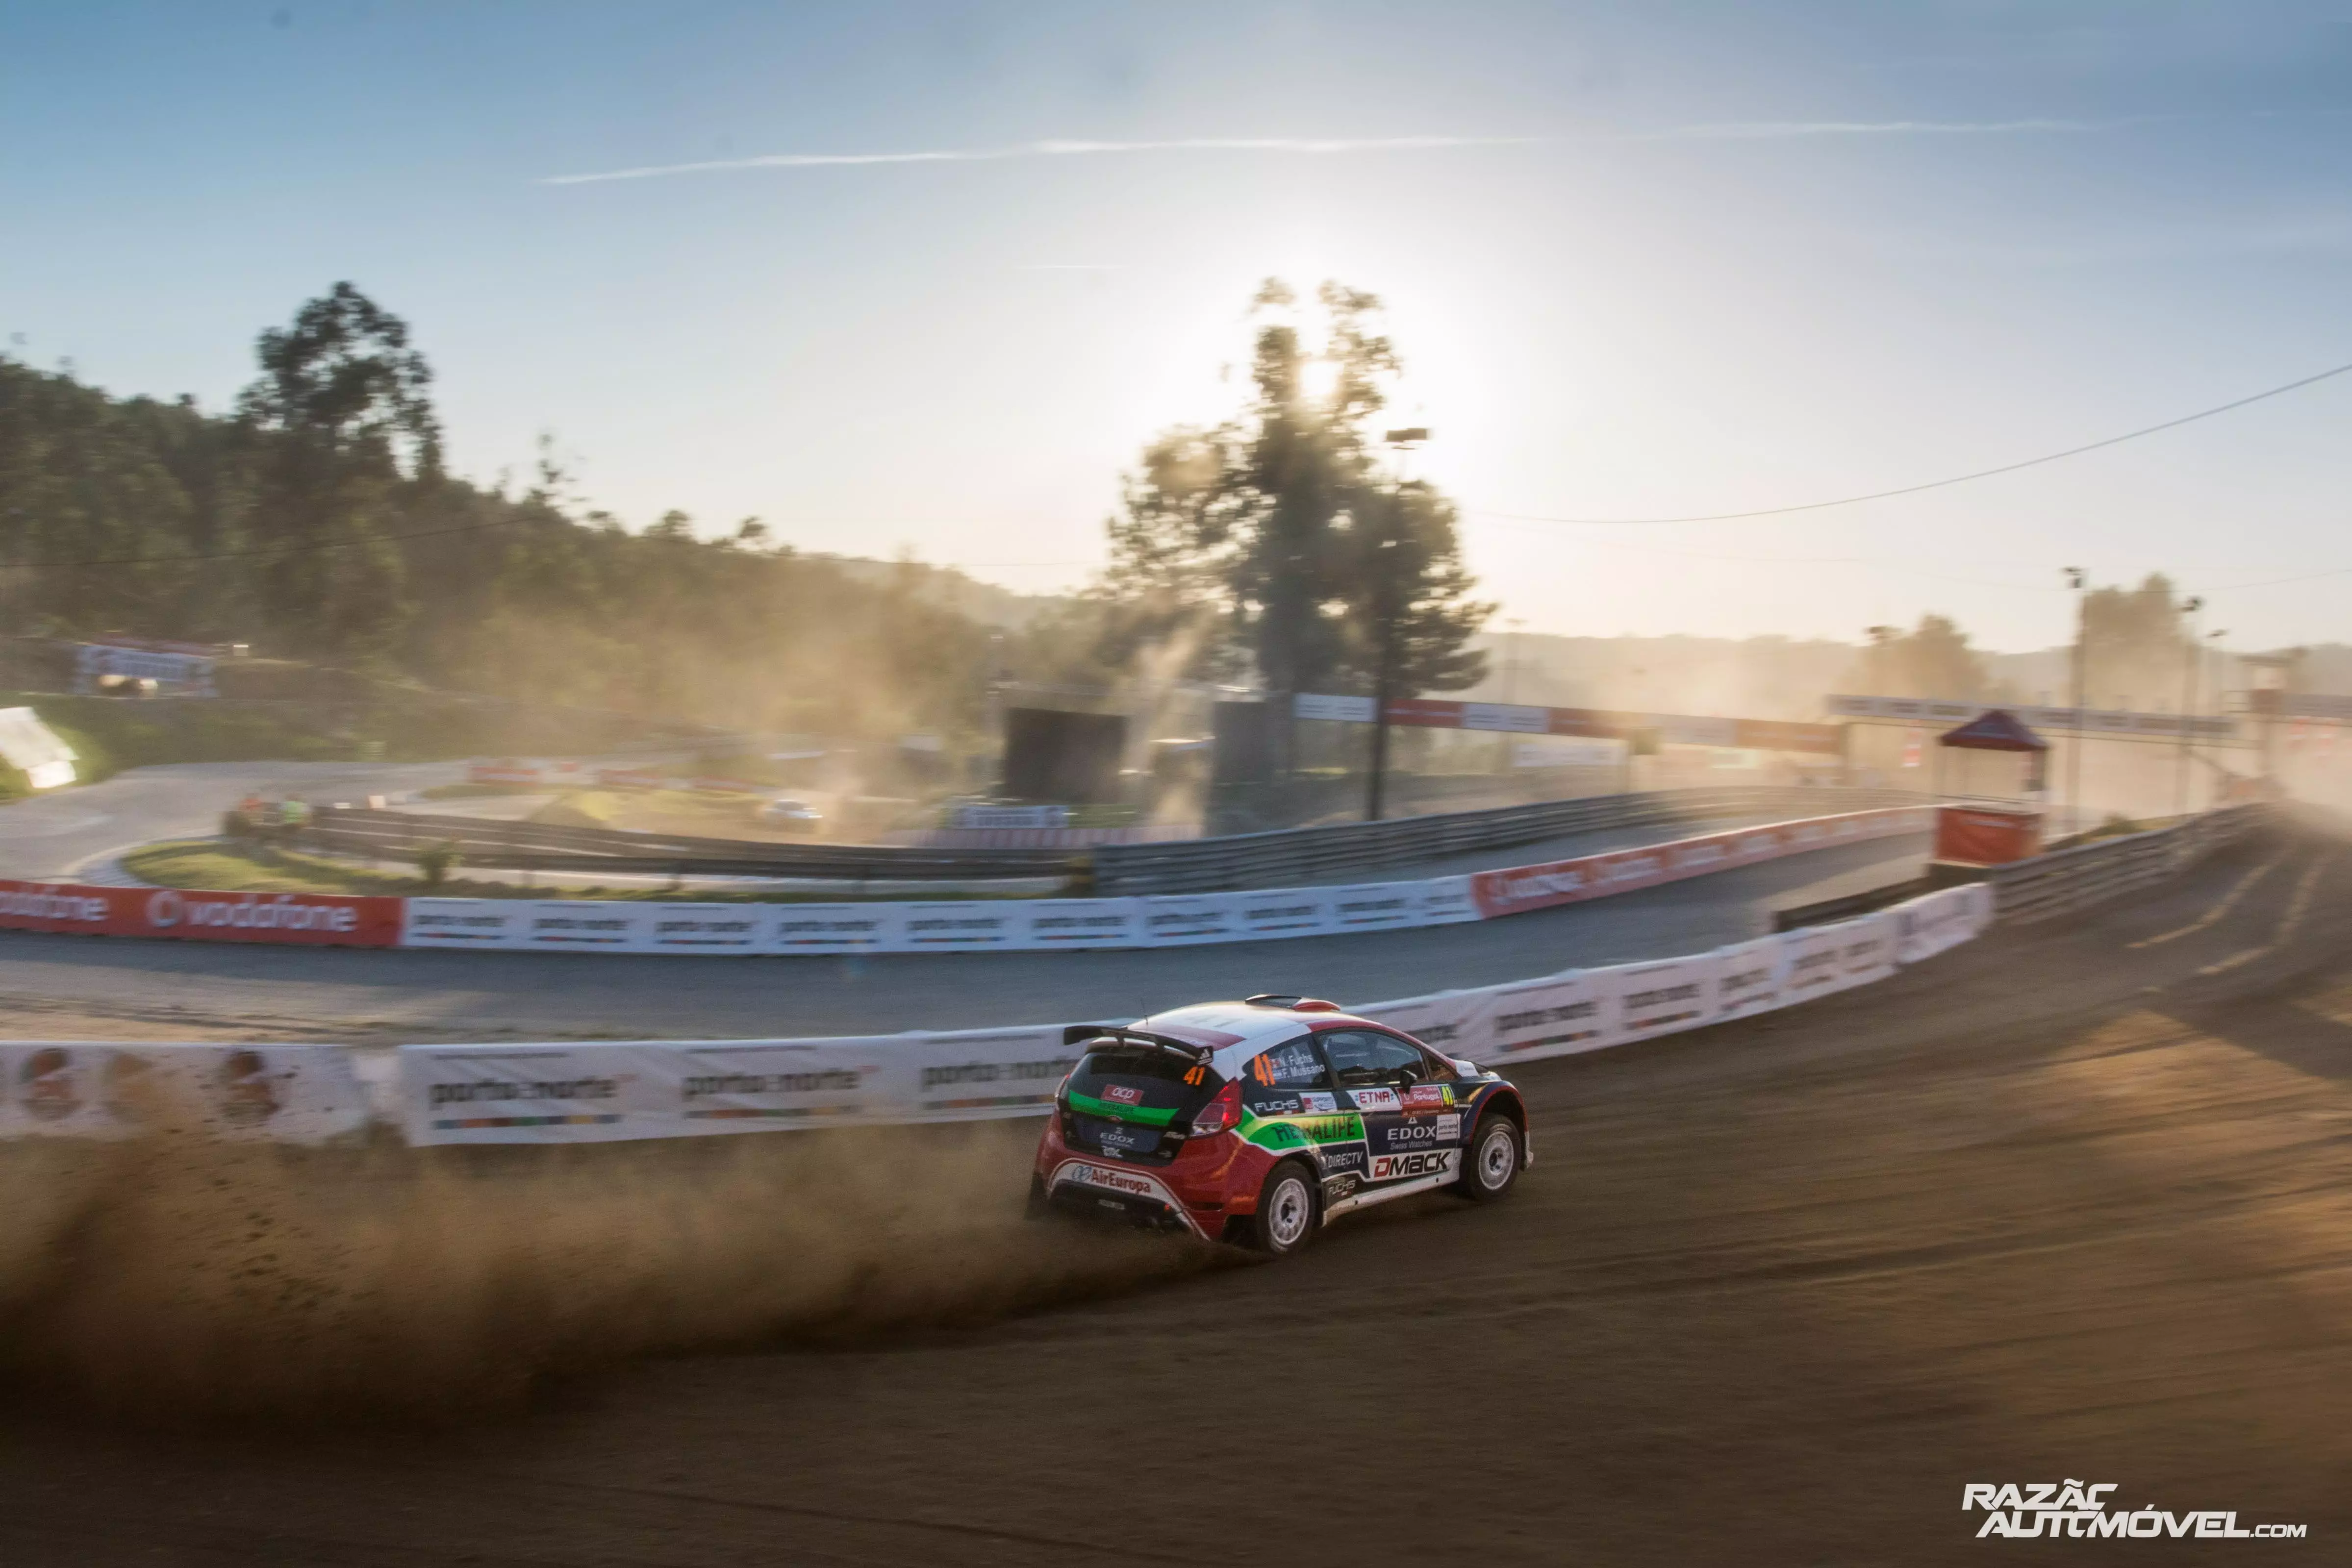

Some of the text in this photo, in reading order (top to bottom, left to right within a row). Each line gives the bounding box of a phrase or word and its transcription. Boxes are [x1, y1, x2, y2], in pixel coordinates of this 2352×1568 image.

[188, 893, 358, 932] vodafone
[1289, 1053, 1314, 1066] Fuchs
[1183, 1066, 1205, 1086] 41
[1254, 1053, 1275, 1086] 41
[1290, 1064, 1325, 1077] Mussano
[1359, 1091, 1391, 1104] ETNA
[1442, 1086, 1454, 1105] 41
[1254, 1099, 1299, 1112] FUCHS
[1099, 1132, 1136, 1144] EDOX
[1274, 1117, 1355, 1142] HEALIFE
[1388, 1125, 1436, 1141] EDOX
[1390, 1140, 1432, 1150] Swiss Watches
[1327, 1150, 1363, 1168] DIRECTV
[1091, 1169, 1151, 1194] AirEuropa
